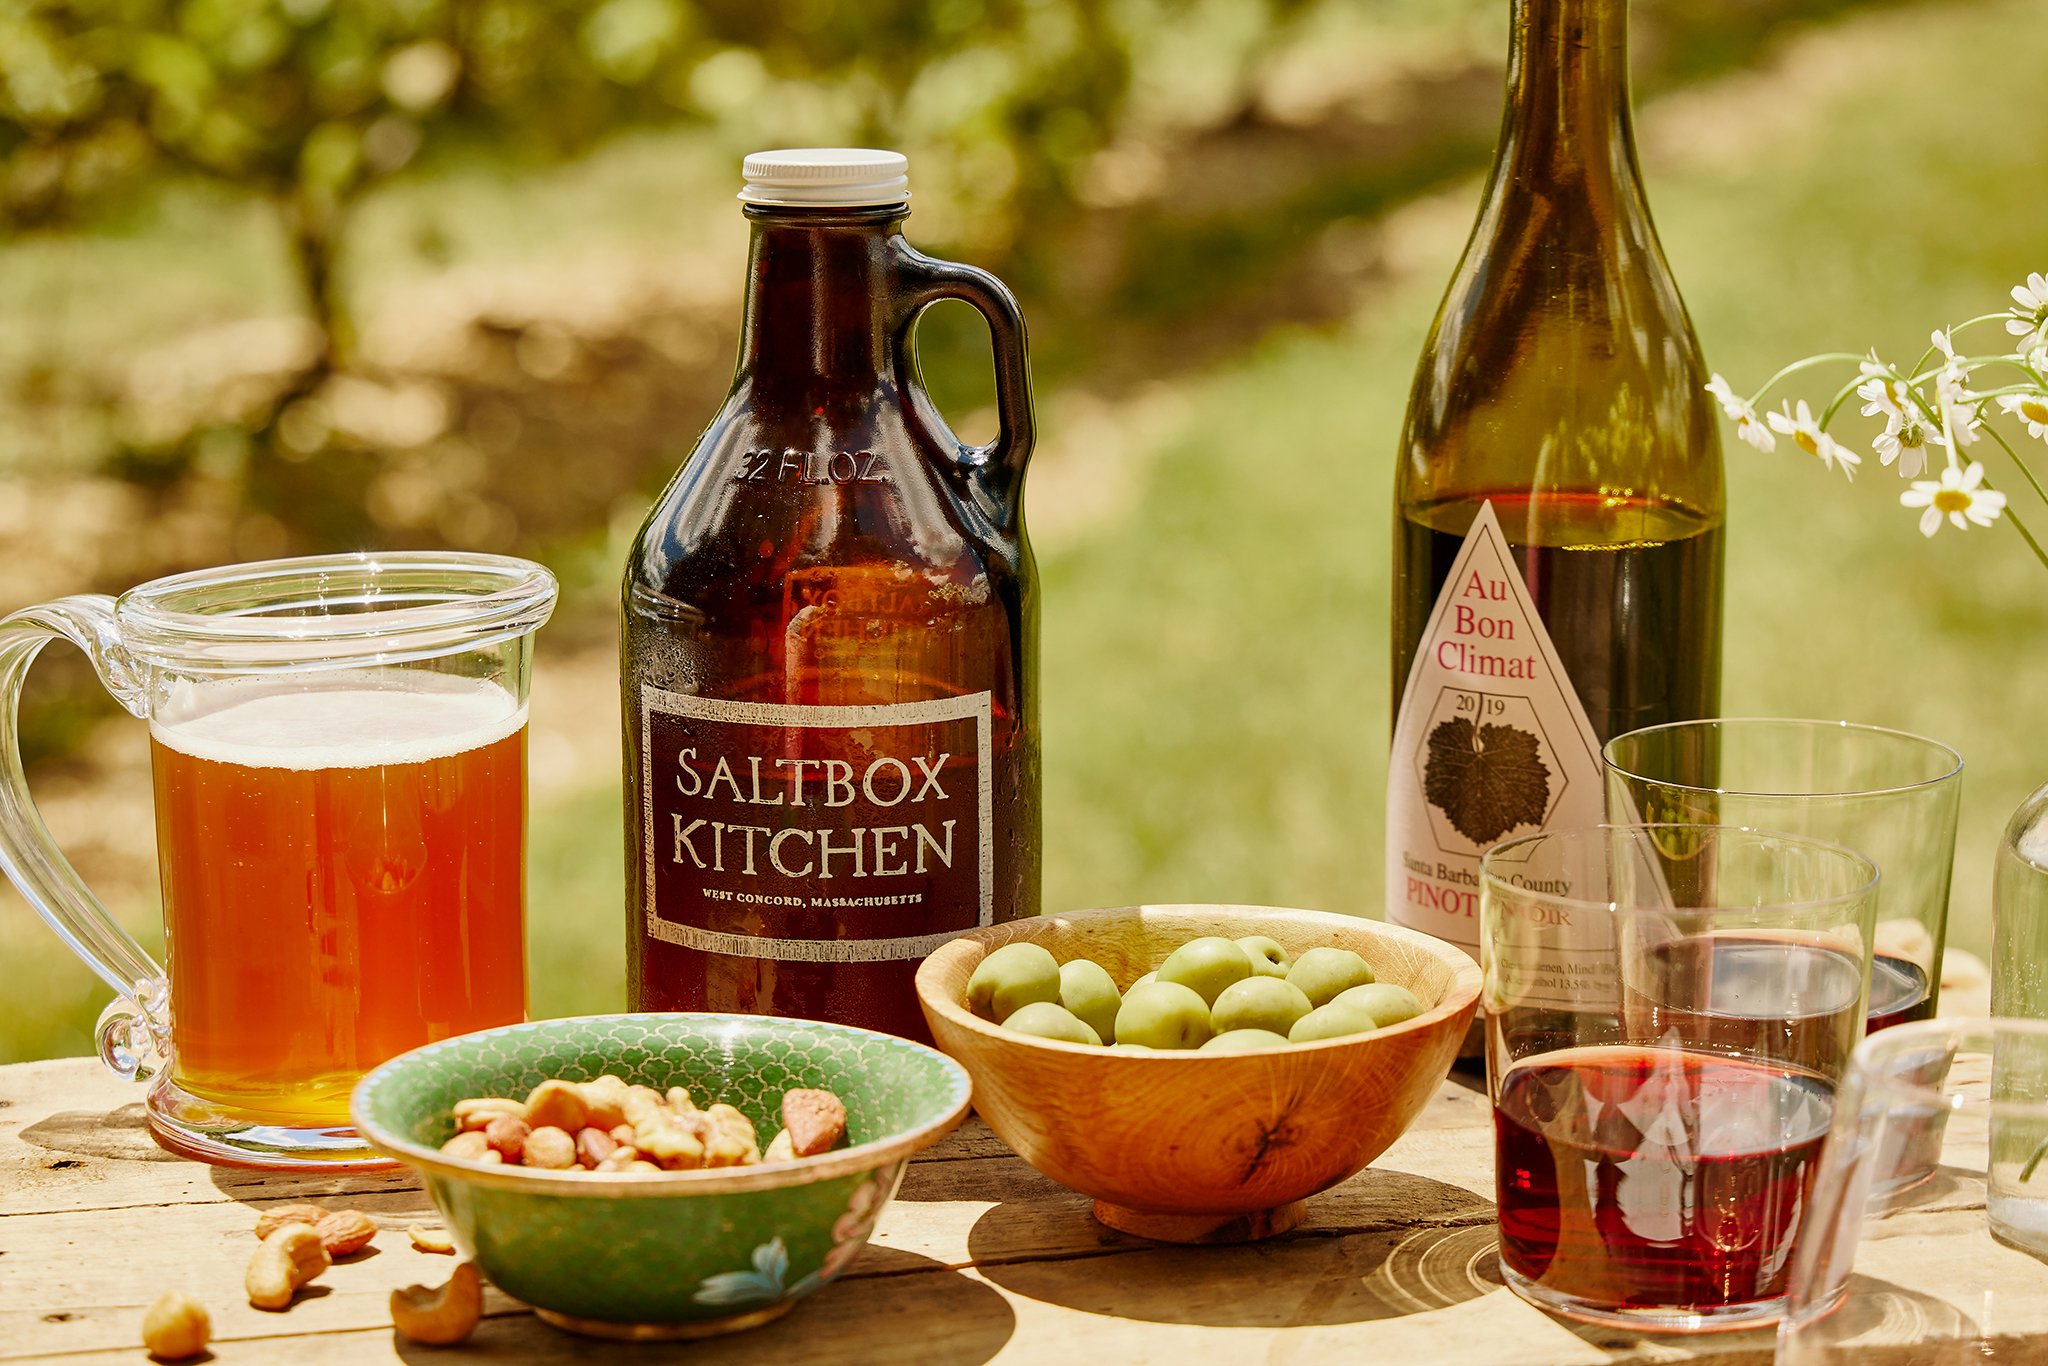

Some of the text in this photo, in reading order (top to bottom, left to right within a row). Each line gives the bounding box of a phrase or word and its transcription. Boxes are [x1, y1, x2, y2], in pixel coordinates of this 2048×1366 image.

[1462, 569, 1507, 601] Au
[1453, 605, 1515, 641] Bon
[1437, 640, 1536, 680] Climat
[676, 747, 951, 808] SALTBOX
[671, 812, 957, 880] KITCHEN
[702, 888, 923, 909] WEST CONCORD, MASSACHUSETTS
[1407, 877, 1479, 918] PINOT
[1511, 874, 1572, 897] County
